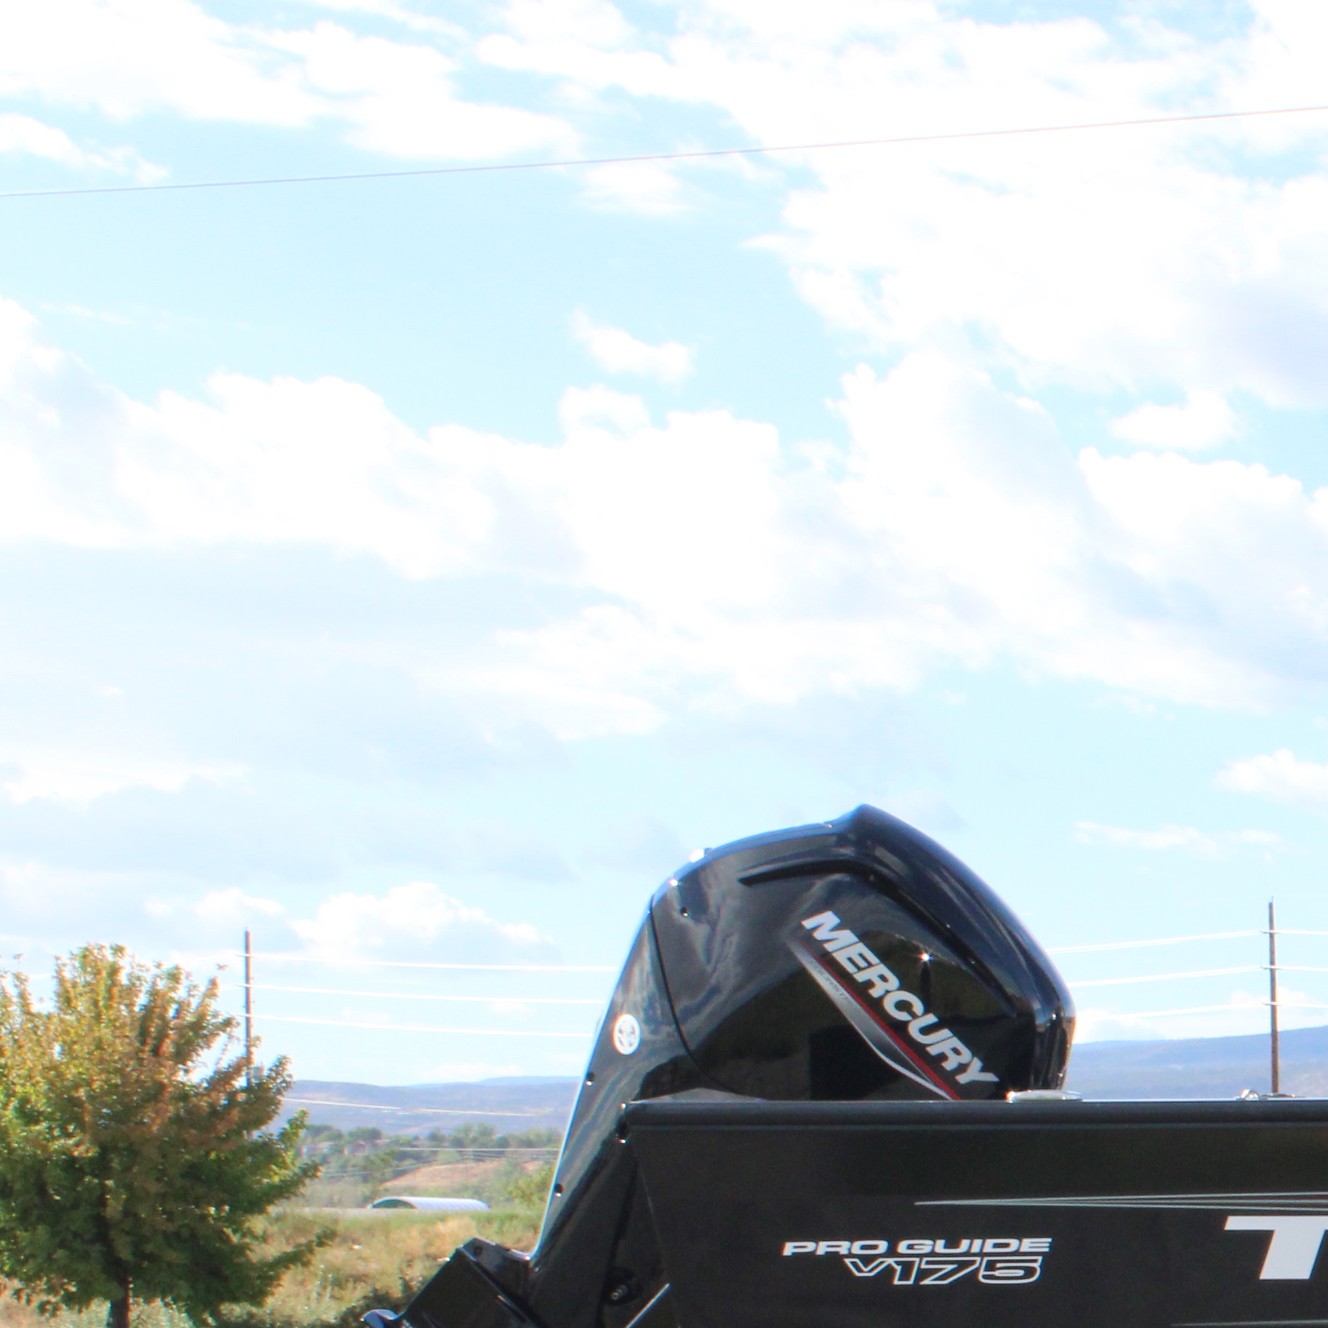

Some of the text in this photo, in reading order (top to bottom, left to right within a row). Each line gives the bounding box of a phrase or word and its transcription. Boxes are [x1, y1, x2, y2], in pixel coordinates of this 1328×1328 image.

[801, 910, 1000, 1086] MERCURY
[782, 1238, 1052, 1256] PRO GUIDE
[843, 1256, 1042, 1285] V175
